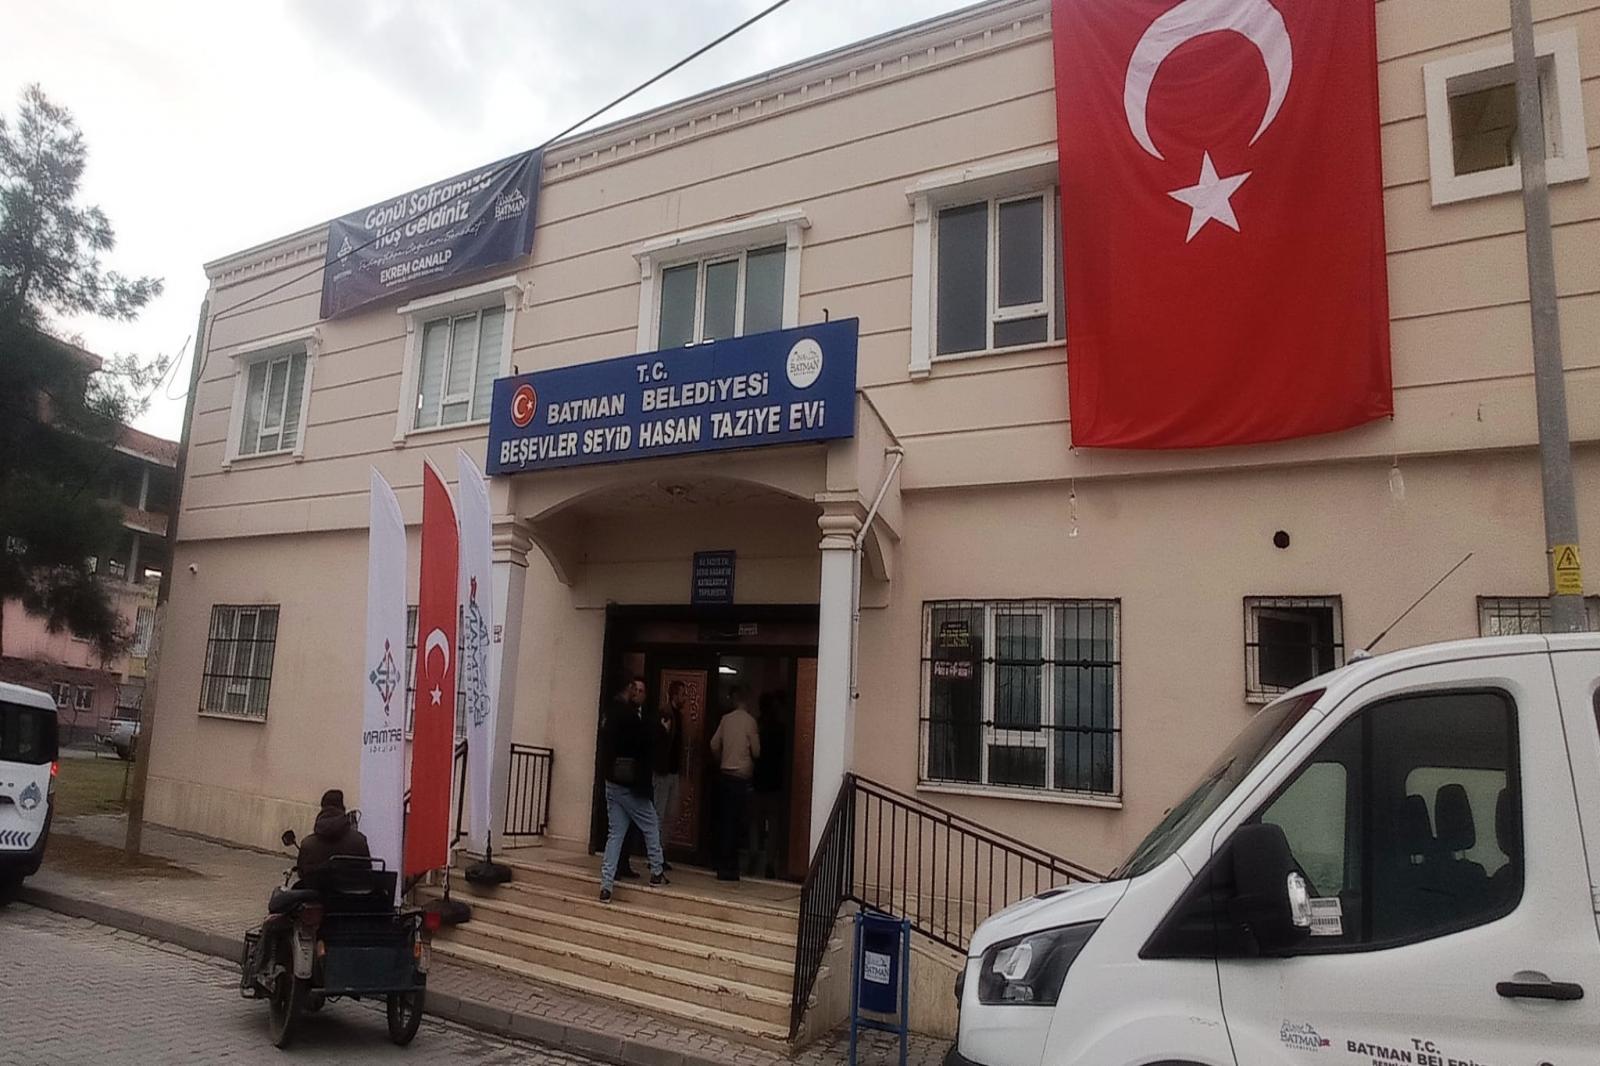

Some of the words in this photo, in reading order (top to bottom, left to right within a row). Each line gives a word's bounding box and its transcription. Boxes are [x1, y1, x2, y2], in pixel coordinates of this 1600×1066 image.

[365, 198, 406, 230] Gönül
[409, 171, 493, 216] Soframıza
[375, 225, 402, 249] Hoş
[405, 200, 470, 237] Geldiniz
[380, 261, 411, 284] EKREM
[411, 249, 452, 273] CANALP
[547, 393, 625, 425] BATMAN
[642, 372, 769, 412] BELEDİYESİ
[500, 431, 578, 467] BEŞEVLER
[582, 426, 632, 453] SEYİD
[639, 416, 701, 448] HASAN
[711, 404, 781, 440] TAZİYE
[789, 400, 825, 430] EVİ
[1347, 1040, 1413, 1063] BATMAN
[1411, 1038, 1441, 1054] T.C.
